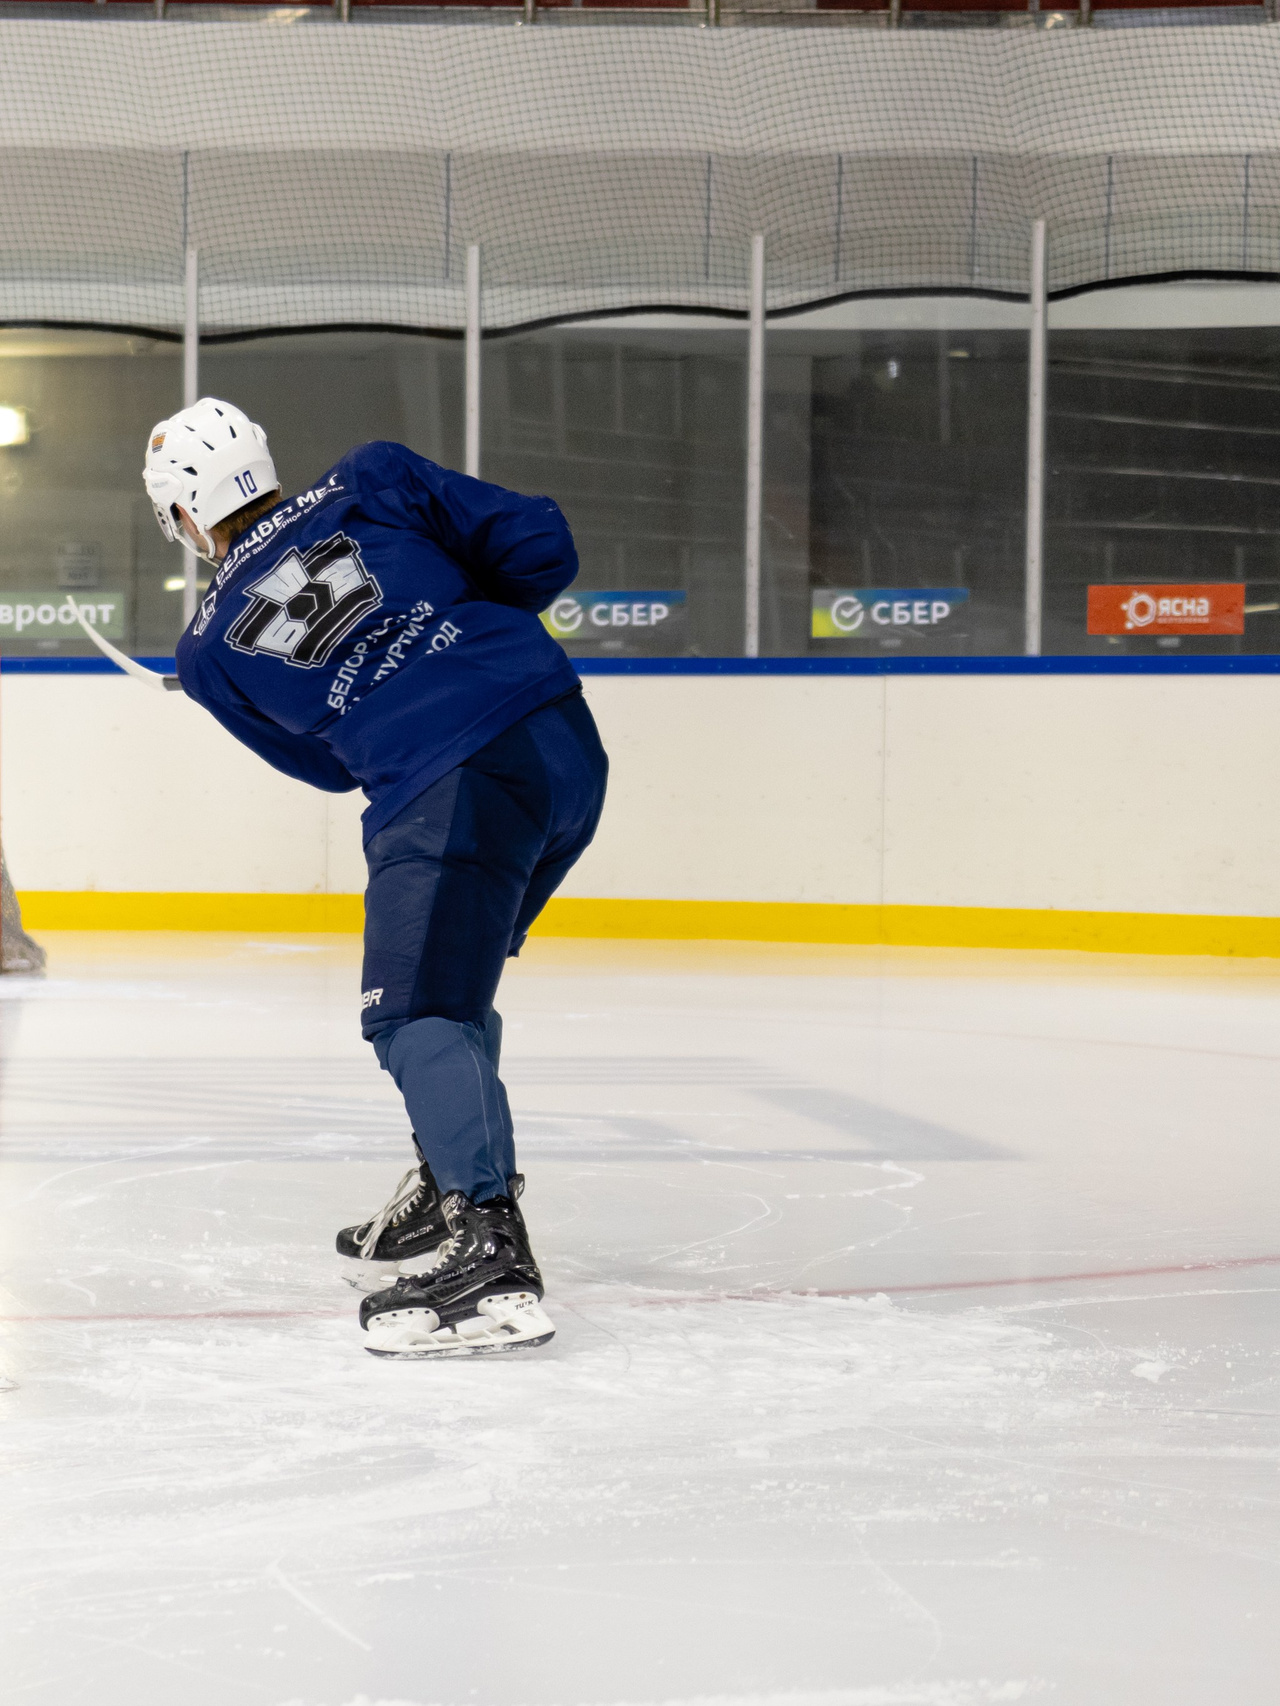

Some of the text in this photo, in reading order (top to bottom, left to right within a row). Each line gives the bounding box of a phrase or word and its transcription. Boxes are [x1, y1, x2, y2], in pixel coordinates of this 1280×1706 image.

[234, 469, 258, 498] 10
[591, 602, 669, 627] СБЕР
[871, 601, 950, 625] СБЕР
[397, 1223, 435, 1245] BAUER
